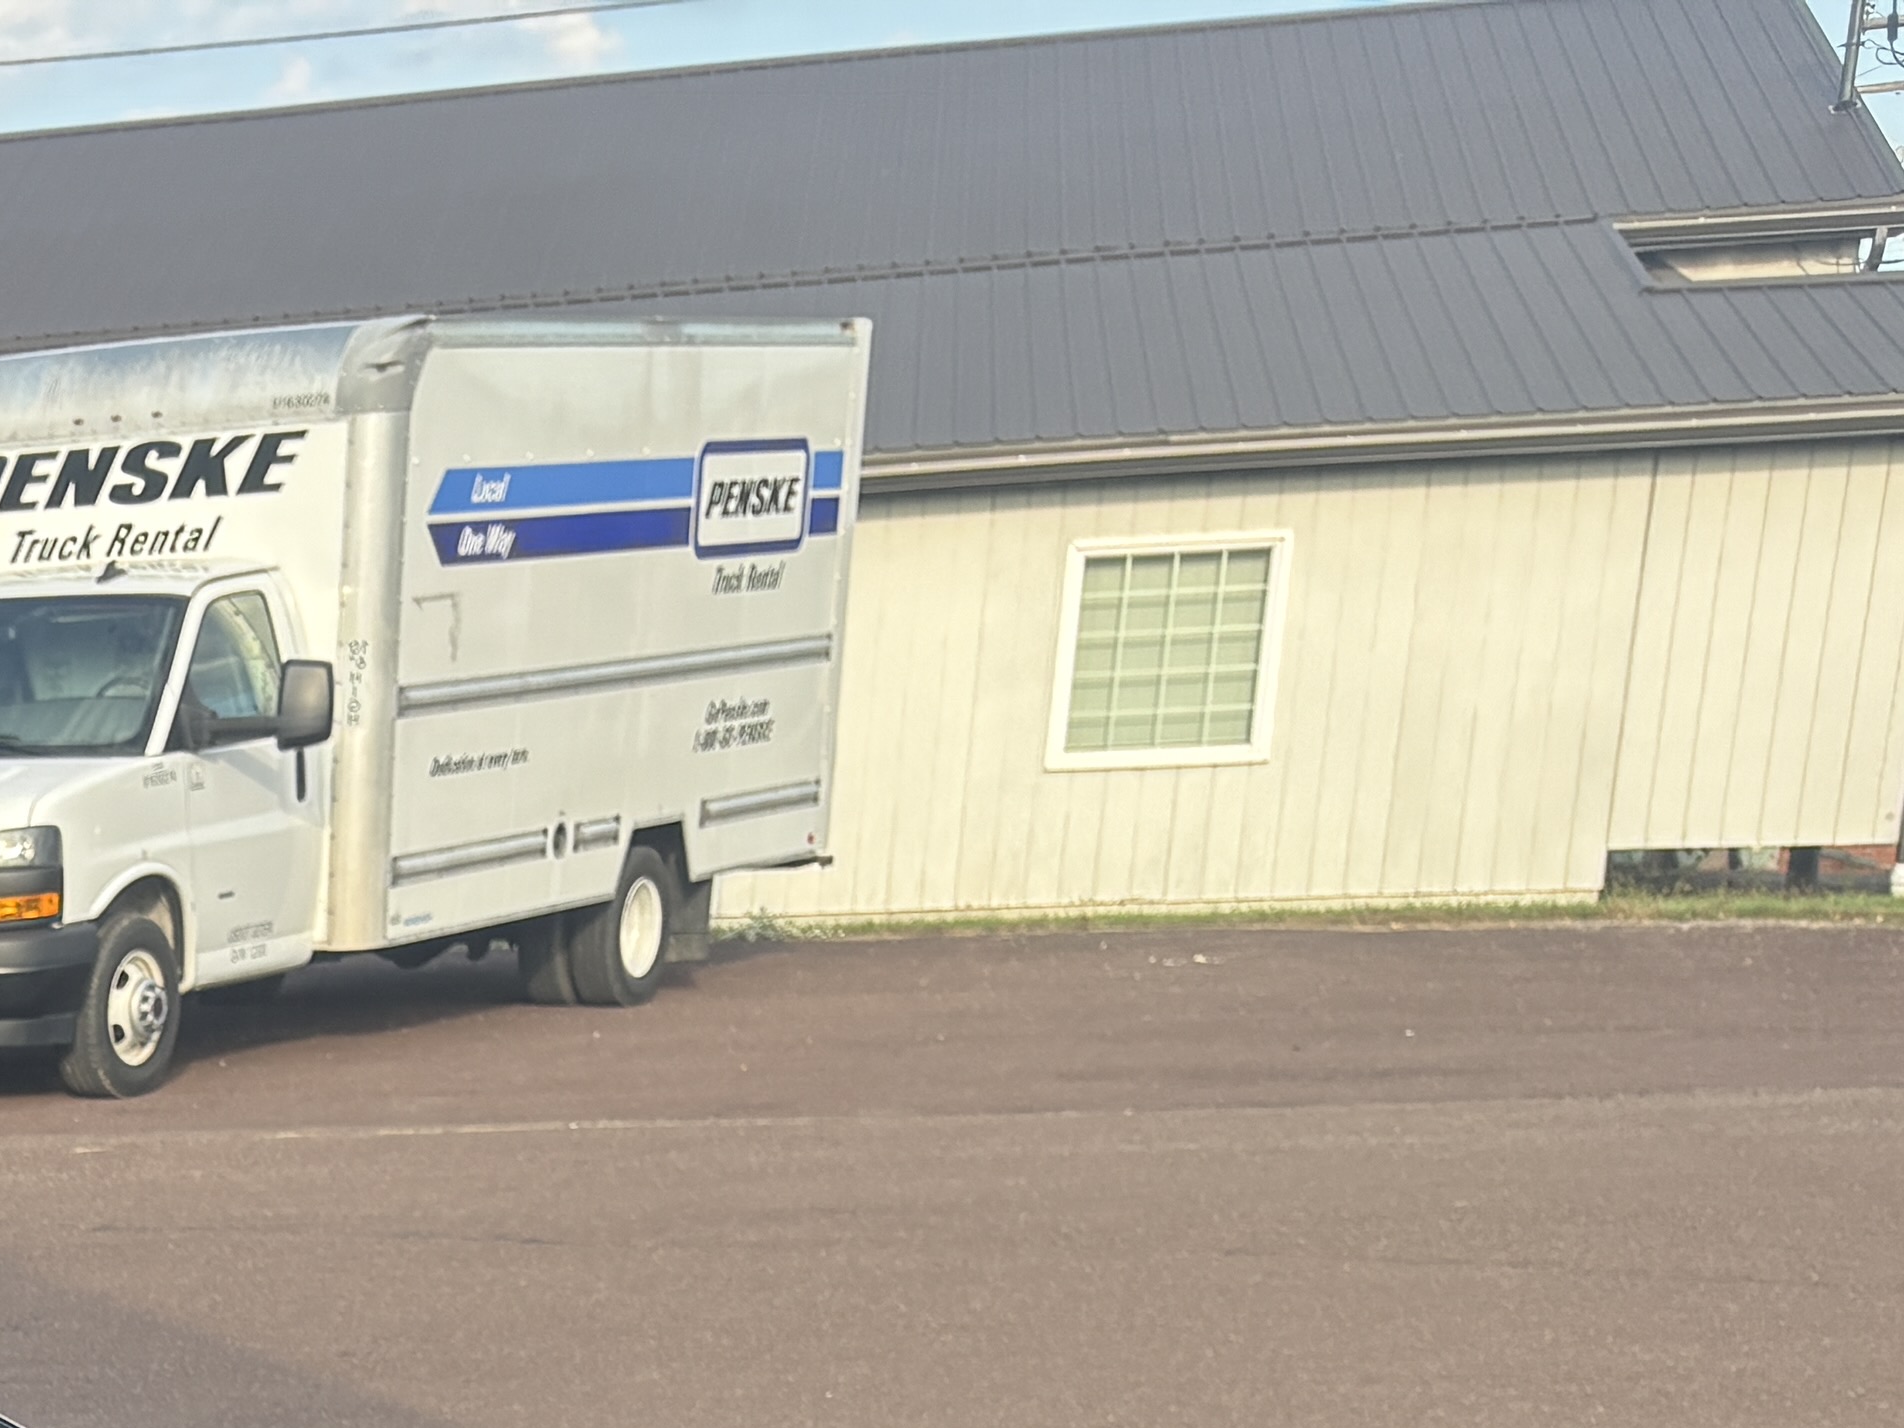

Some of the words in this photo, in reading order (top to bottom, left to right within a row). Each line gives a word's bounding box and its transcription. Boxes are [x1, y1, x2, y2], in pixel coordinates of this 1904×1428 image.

[471, 472, 511, 504] Local
[705, 476, 801, 519] PENSKE
[10, 524, 101, 564] Truck
[106, 515, 224, 557] Rental
[457, 525, 485, 556] One
[485, 523, 516, 560] Way
